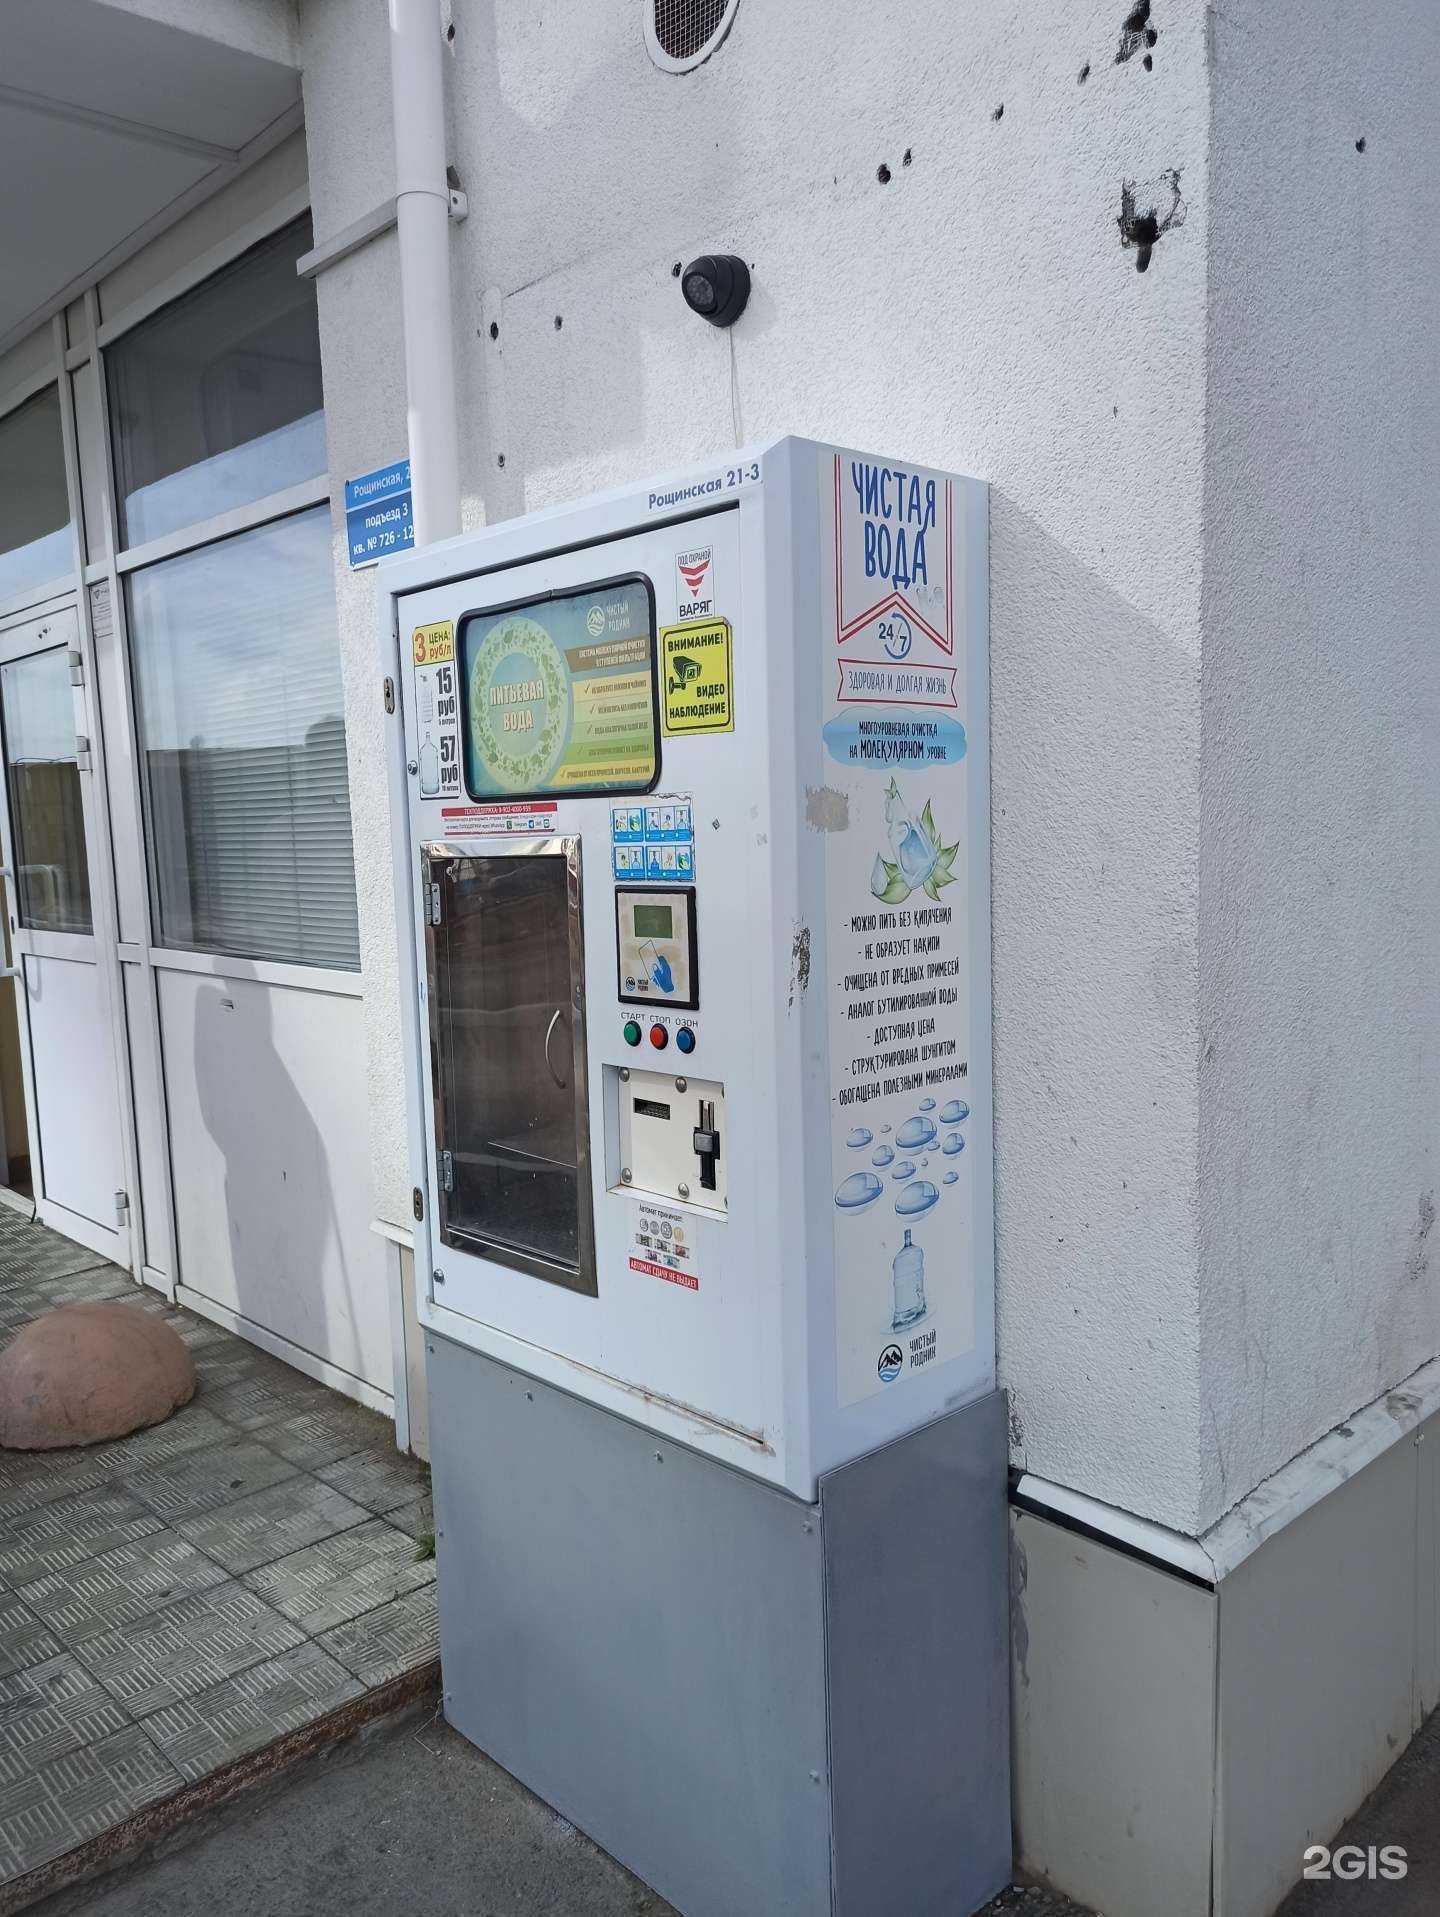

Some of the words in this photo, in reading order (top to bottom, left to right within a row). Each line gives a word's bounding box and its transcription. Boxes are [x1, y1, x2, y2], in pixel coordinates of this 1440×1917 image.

[354, 472, 403, 498] Рощинская,
[648, 479, 722, 509] Рощинская
[726, 463, 760, 487] 21-3
[851, 462, 936, 530] ЧИСТАЯ
[365, 507, 401, 528] подъезд
[403, 503, 408, 516] 3
[353, 544, 365, 555] кв.
[367, 536, 377, 550] №
[380, 531, 395, 547] 726
[864, 520, 928, 590] ВОДА
[679, 600, 713, 618] ВАРЯГ
[414, 632, 426, 662] 3
[429, 631, 451, 644] ЦЕНА:
[668, 633, 723, 652] ВНИМАНИЕ!
[878, 622, 908, 652] 24/7
[429, 644, 452, 660] руб/л
[435, 667, 453, 695] 15
[490, 680, 544, 706] ПИТЬЕВАЯ
[696, 684, 725, 699] ВИДЕО
[848, 670, 884, 692] ЗДОРОВАЯ
[887, 674, 893, 691] И
[895, 675, 923, 694] ДОЛГАЯ
[925, 676, 947, 695] ЖИЗНЬ
[437, 696, 455, 717] руб
[669, 702, 726, 719] НАБЛЮДЕНИЕ
[503, 709, 534, 732] ВОДА
[859, 721, 910, 738] МНОГОУРОВНЕВАЯ
[911, 722, 938, 739] ОЧИСТКА
[440, 735, 456, 762] 57
[849, 744, 858, 759] НА
[860, 739, 924, 762] МОЛЕКУЛЯРНОМ
[926, 745, 947, 760] УРОВНЕ
[441, 764, 458, 784] руб
[851, 915, 876, 933] МОЖНО
[879, 913, 897, 930] ПИТЬ
[899, 911, 911, 928] БЕЗ
[914, 907, 952, 928] КИПЯЧЕНИЯ
[865, 943, 873, 960] НЕ
[875, 939, 910, 959] ОБРАЗУЕТ
[913, 936, 940, 955] НАКИПИ
[844, 972, 878, 992] ОЧИЩЕНА
[880, 970, 890, 986] ОТ
[892, 965, 924, 985] ВРЕДНЫХ
[927, 956, 959, 979] ПРИМЕСЕЙ
[847, 1000, 874, 1020] АНАЛОГ
[877, 987, 937, 1015] БУТИЛИРОВАННОЙ
[939, 987, 958, 1005] ВОДЫ
[620, 1012, 645, 1021] СТАРТ
[649, 1014, 671, 1024] СТОП
[675, 1018, 698, 1028] ОЗОН
[873, 1021, 915, 1046] ДОСТУПНАЯ
[917, 1017, 935, 1038] ЦЕНА
[851, 1047, 918, 1076] СТРУКТУРИРОВАНА
[921, 1039, 956, 1060] ШУНГИТОМ
[839, 1082, 881, 1106] ОБОГАЩЕНА
[883, 1072, 923, 1095] ПОЛЕЗНЫМИ
[925, 1062, 968, 1086] МИНЕРАЛАМИ
[631, 1259, 652, 1275] АВТОМАТ
[652, 1266, 667, 1279] СДАЧУ
[668, 1271, 676, 1281] НЕ
[676, 1274, 697, 1287] ВЫДАЕТ
[909, 1328, 936, 1352] ЧИСТЫЙ
[910, 1346, 936, 1368] РОДНИК
